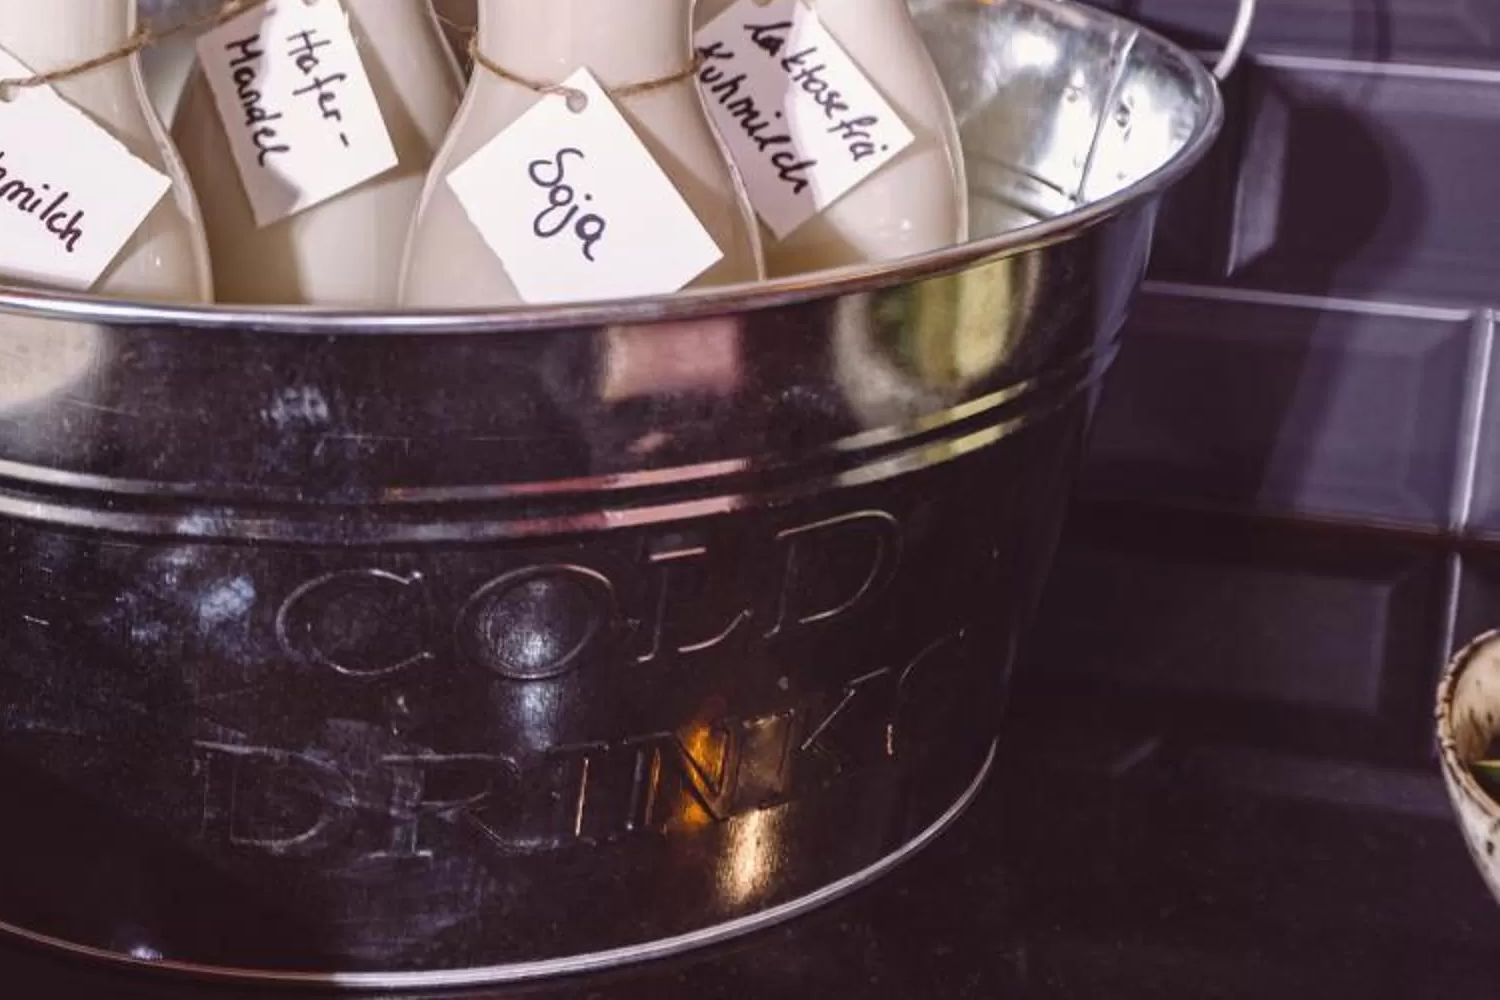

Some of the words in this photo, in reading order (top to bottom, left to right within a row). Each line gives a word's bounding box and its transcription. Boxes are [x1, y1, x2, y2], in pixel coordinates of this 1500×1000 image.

[226, 33, 290, 168] Mandel
[528, 147, 607, 262] Soja
[274, 508, 902, 681] COLD
